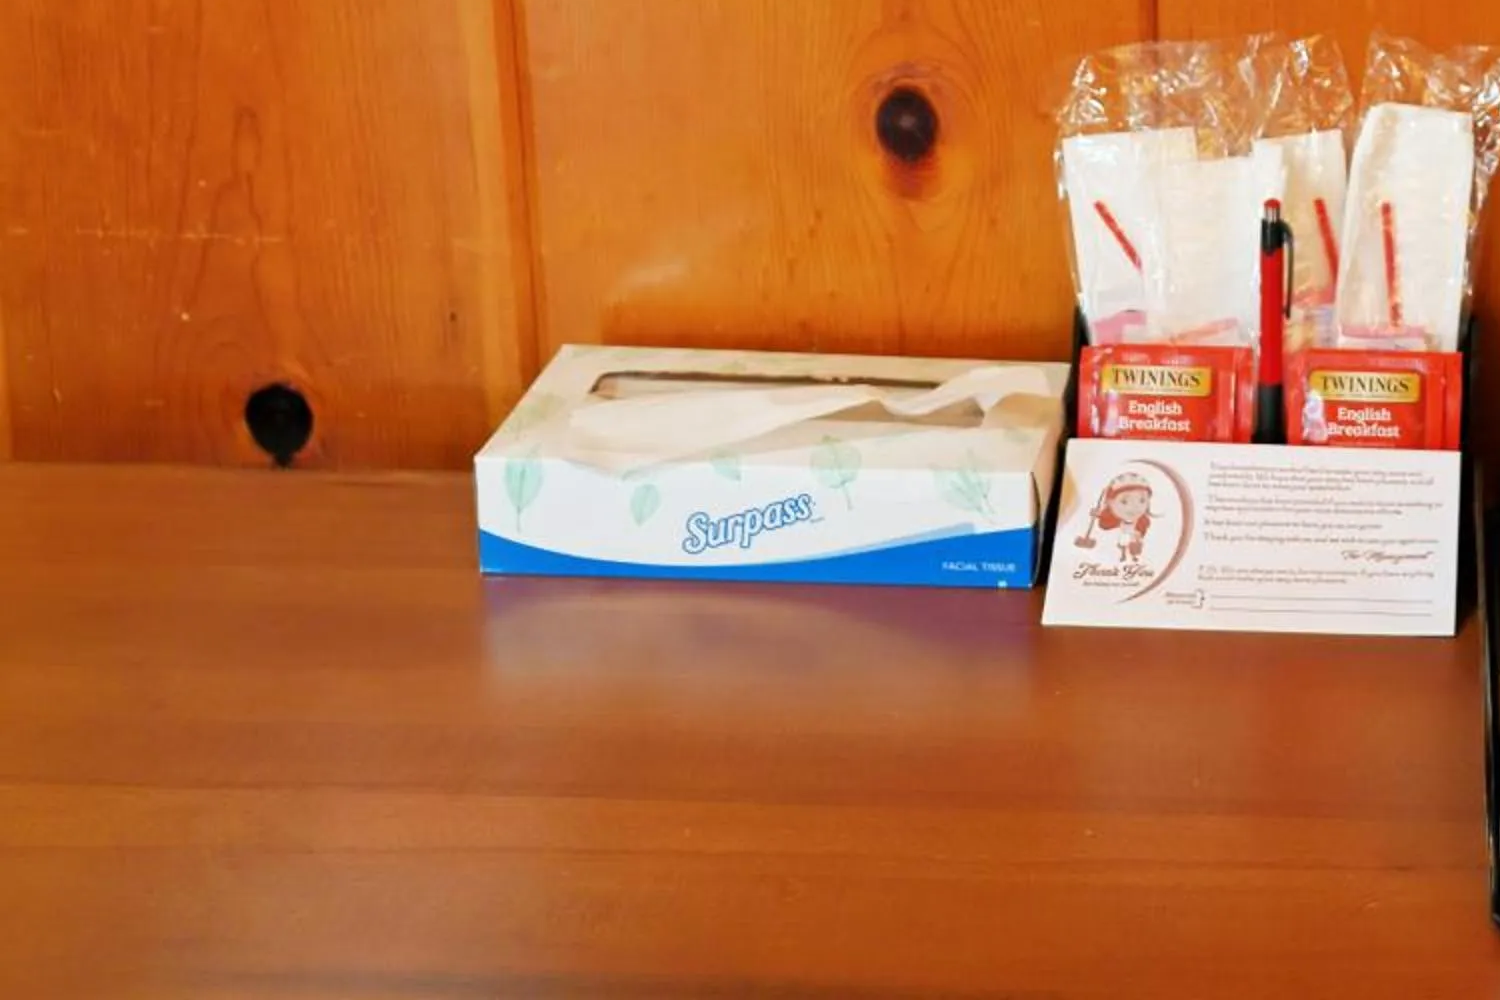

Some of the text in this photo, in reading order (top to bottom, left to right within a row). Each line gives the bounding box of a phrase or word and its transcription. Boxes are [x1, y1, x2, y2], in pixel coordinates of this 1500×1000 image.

[1112, 366, 1201, 388] TWININGS
[1321, 375, 1410, 394] TWININGS
[1128, 400, 1183, 418] English
[1337, 407, 1392, 424] English
[1118, 415, 1191, 432] Breakfast
[1327, 421, 1400, 438] Breakfast
[682, 493, 812, 554] Surpass
[942, 561, 1016, 573] FACIAL TISSUE
[1073, 562, 1154, 580] Thank You
